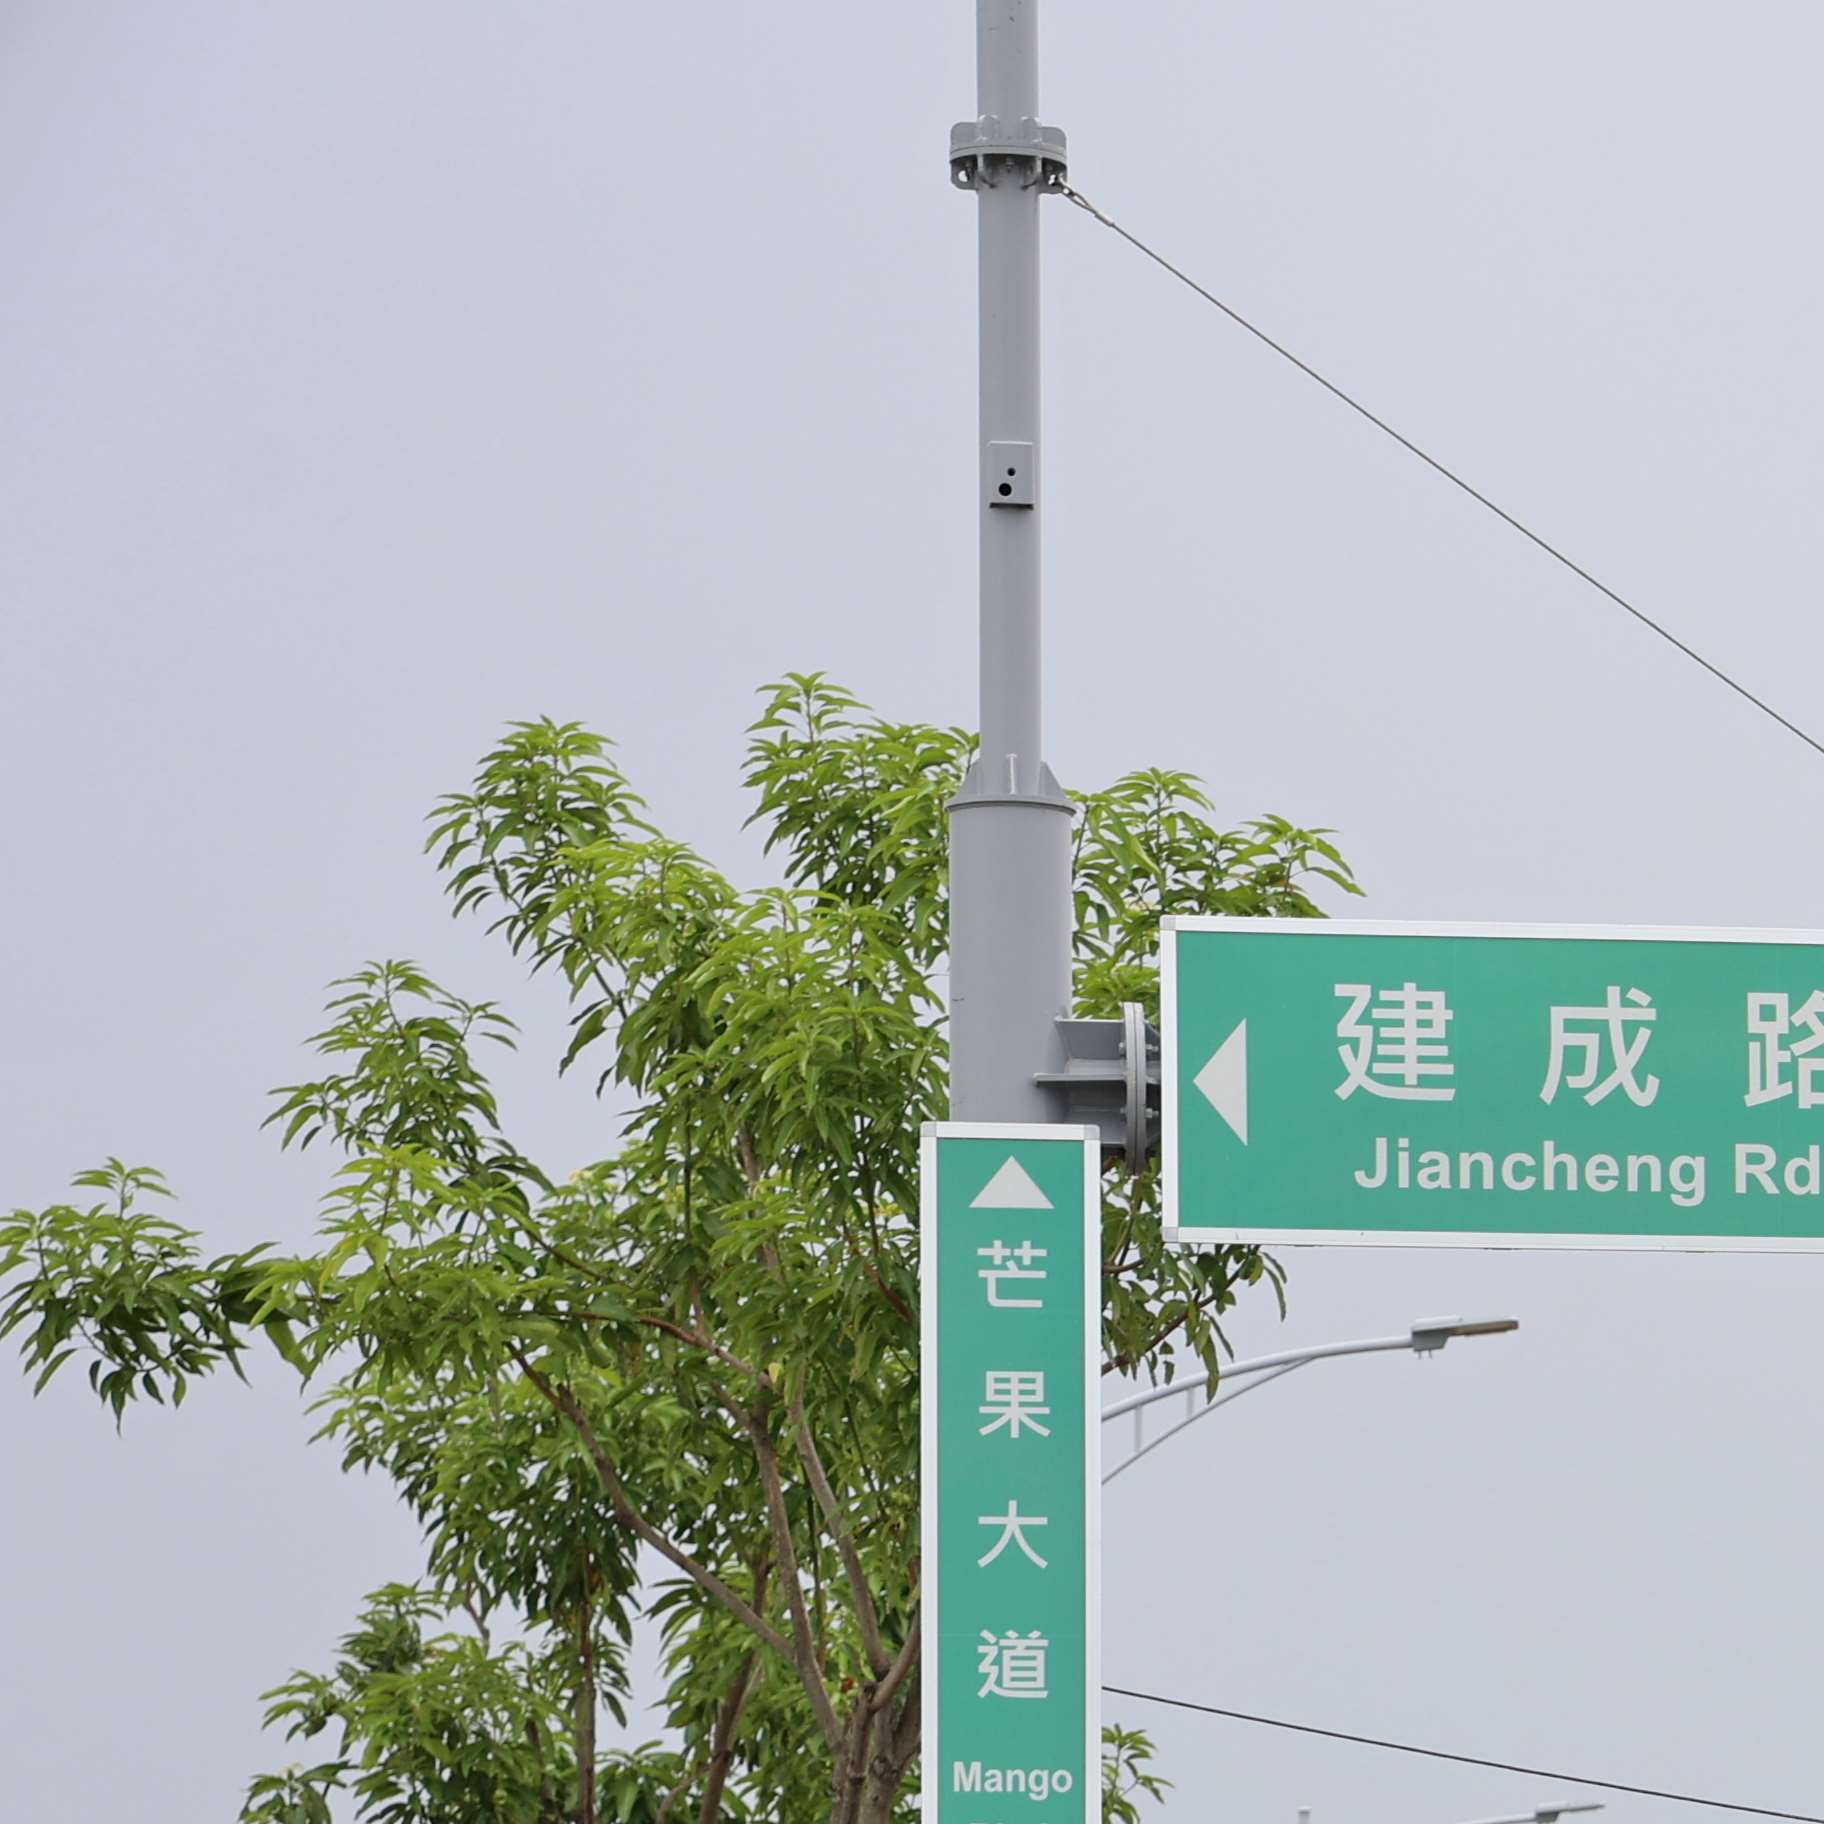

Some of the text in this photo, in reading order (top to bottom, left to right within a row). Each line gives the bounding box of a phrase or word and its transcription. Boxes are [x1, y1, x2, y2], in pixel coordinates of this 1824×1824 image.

[1354, 1136, 1706, 1207] Jiancheng
[976, 1239, 1051, 1699] 芒果大道
[953, 1760, 1073, 1797] Mango
